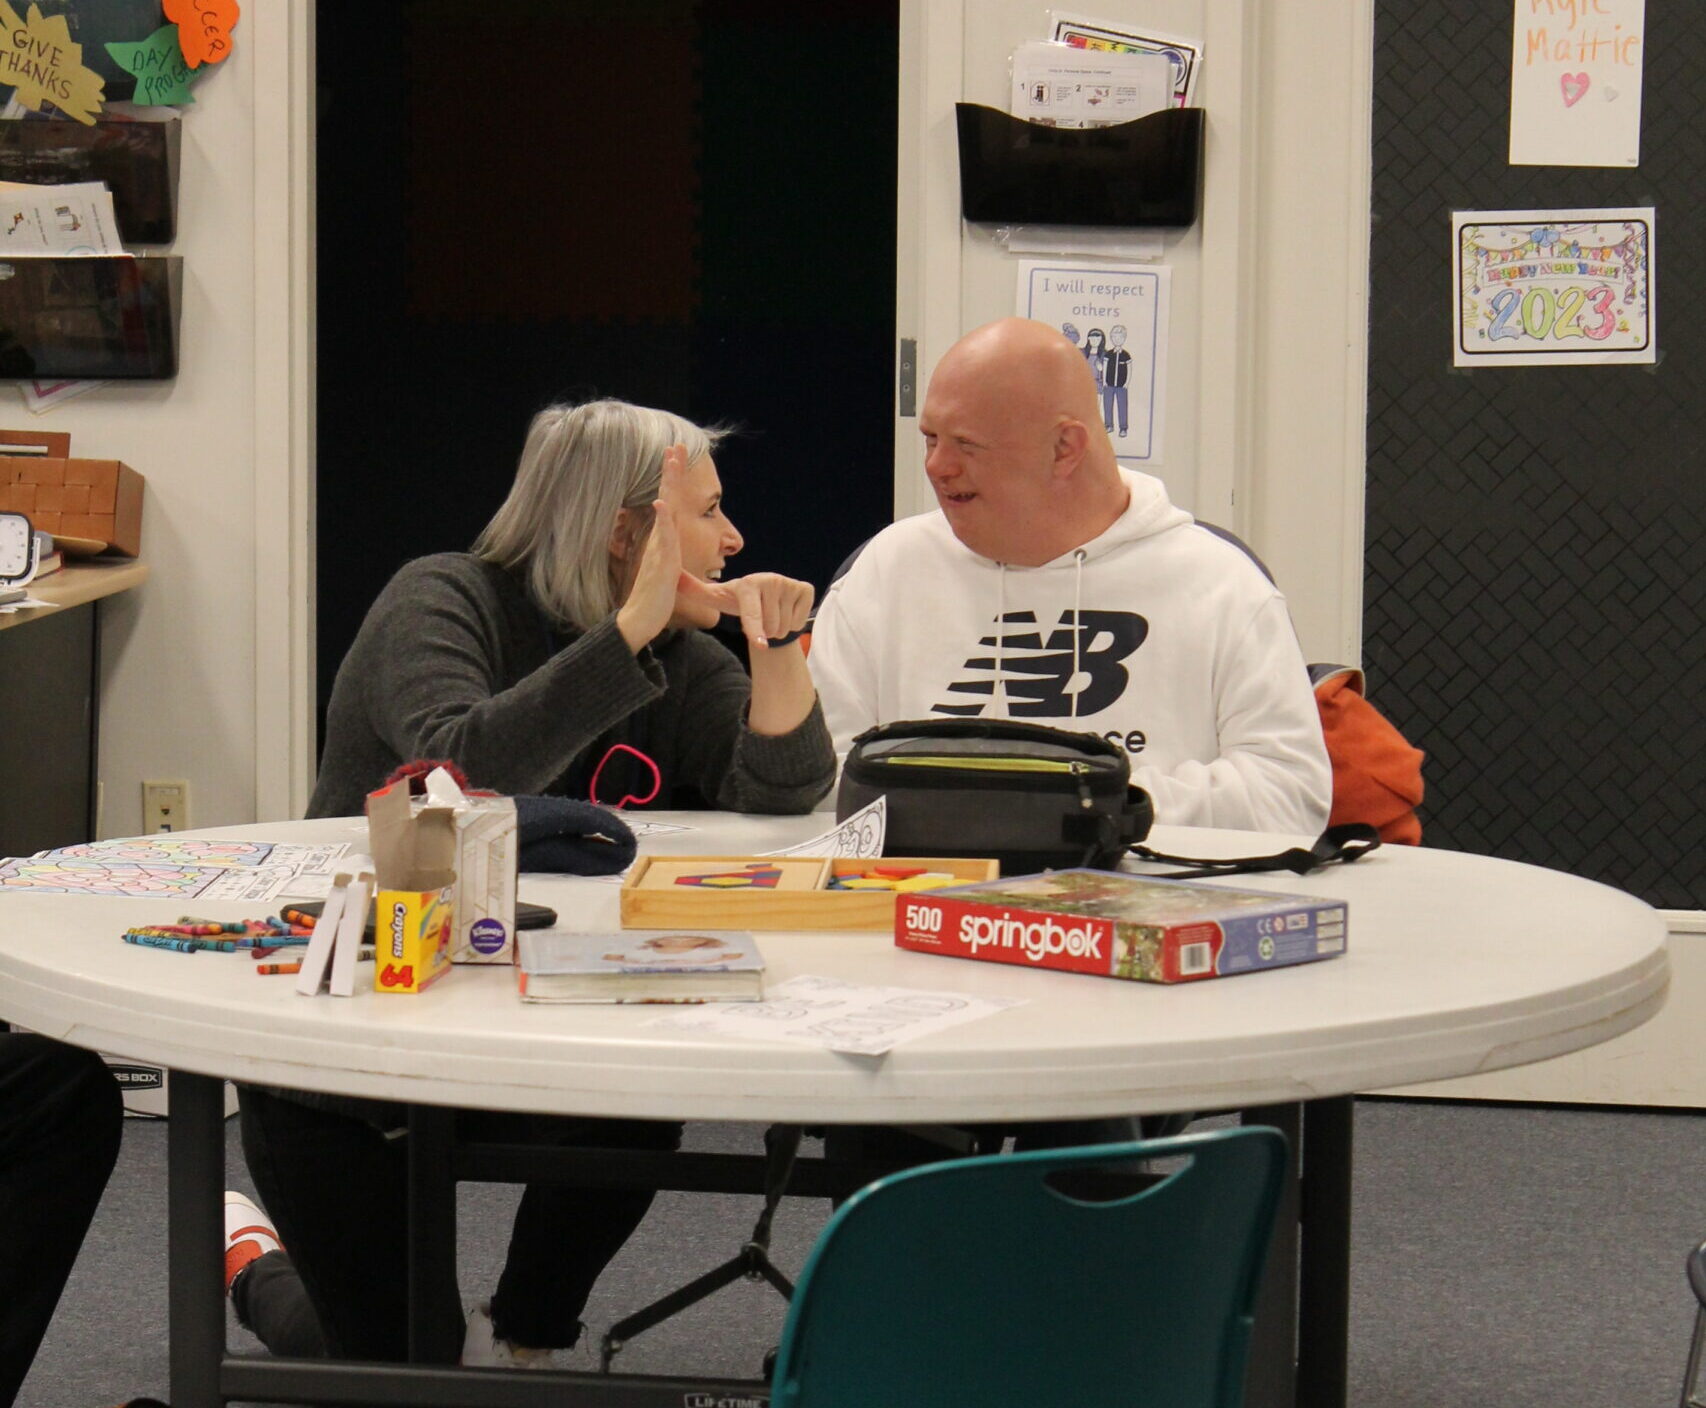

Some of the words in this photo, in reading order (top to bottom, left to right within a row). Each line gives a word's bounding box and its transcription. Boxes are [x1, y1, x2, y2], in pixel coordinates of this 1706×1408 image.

[13, 29, 63, 68] GIVE
[132, 45, 173, 72] DAY
[1525, 24, 1641, 67] Mattie
[0, 50, 73, 100] THANKS
[144, 63, 190, 106] PROG
[1075, 84, 1082, 93] 2
[1078, 120, 1084, 129] 4
[1043, 278, 1050, 292] I
[1056, 280, 1084, 294] will
[1090, 284, 1145, 300] respect
[1072, 303, 1120, 318] others
[1487, 286, 1616, 341] 2023
[906, 904, 943, 932] 500
[958, 912, 1102, 961] springbok
[380, 963, 415, 988] 64
[131, 1072, 159, 1082] BOX
